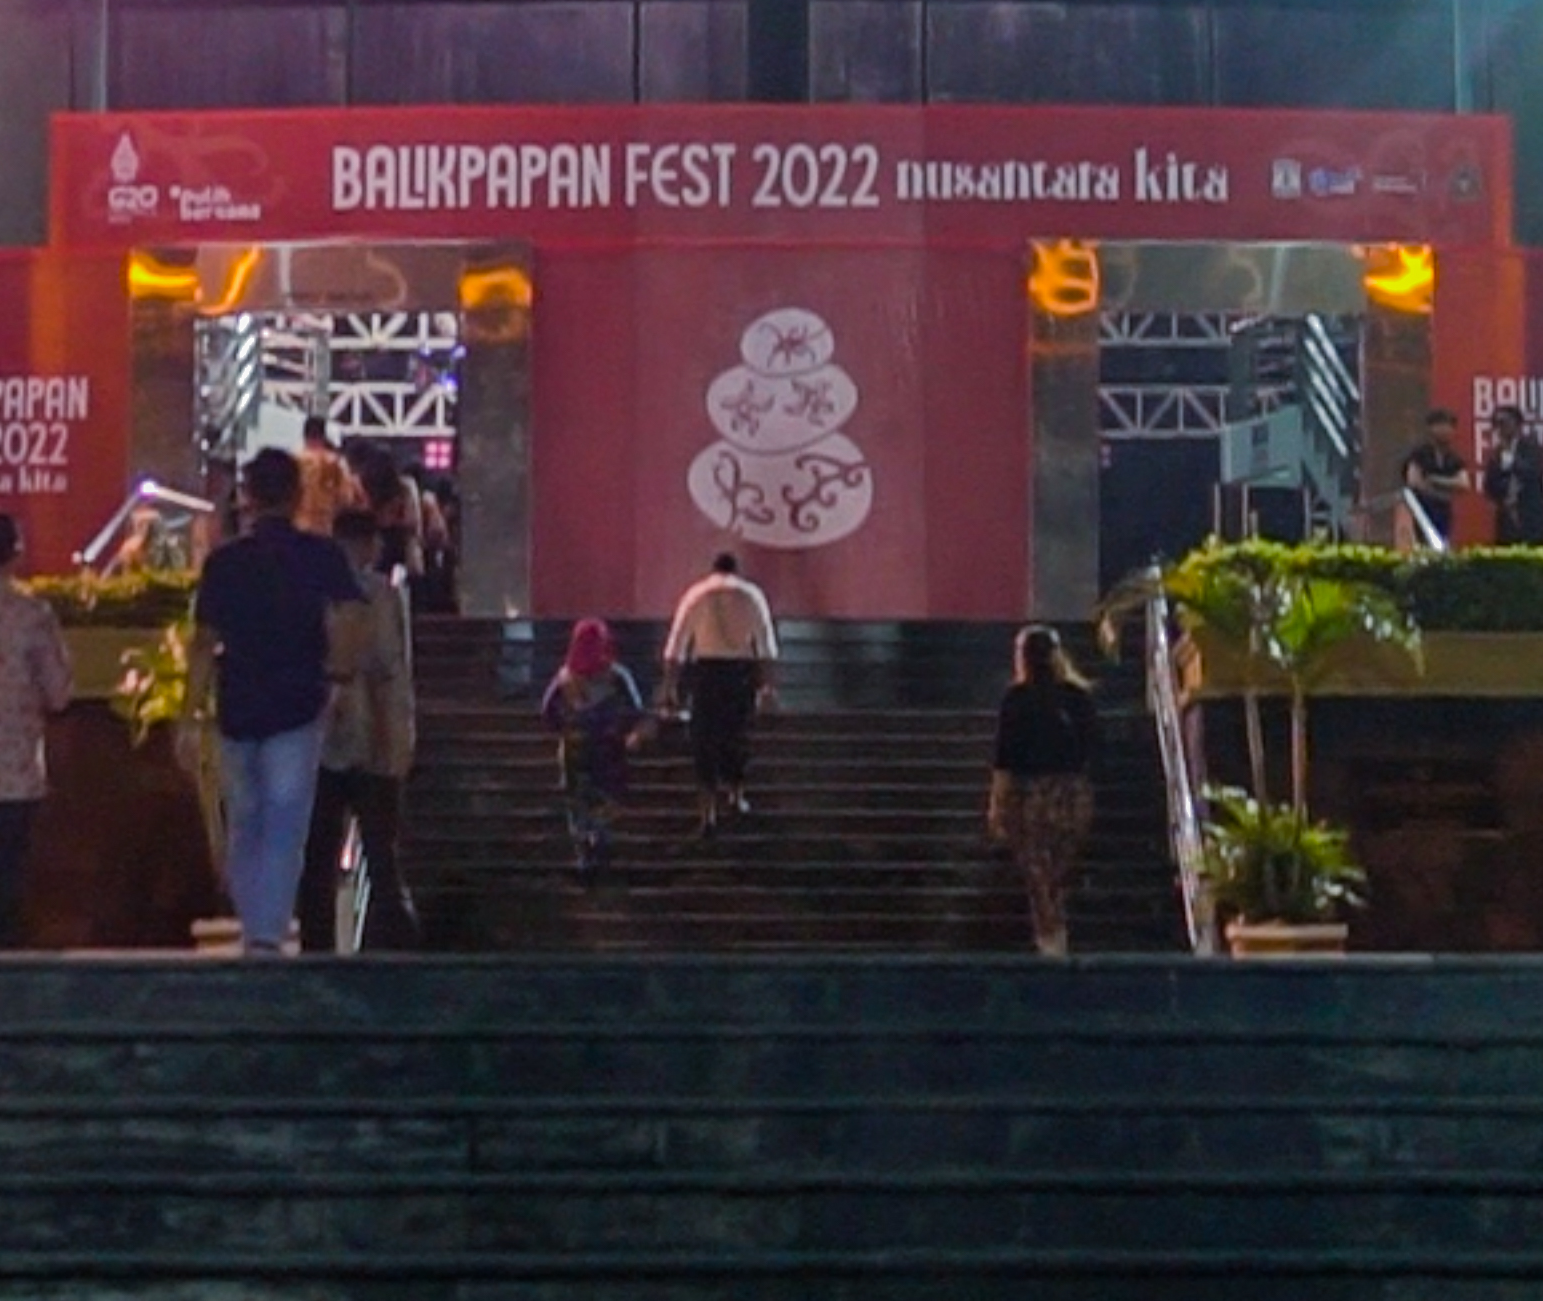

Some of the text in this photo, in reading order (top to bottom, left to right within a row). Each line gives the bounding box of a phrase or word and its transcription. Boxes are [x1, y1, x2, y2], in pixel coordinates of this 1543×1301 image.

[331, 142, 1229, 210] BALIKPAPAN FEST 2022 nusantara kita
